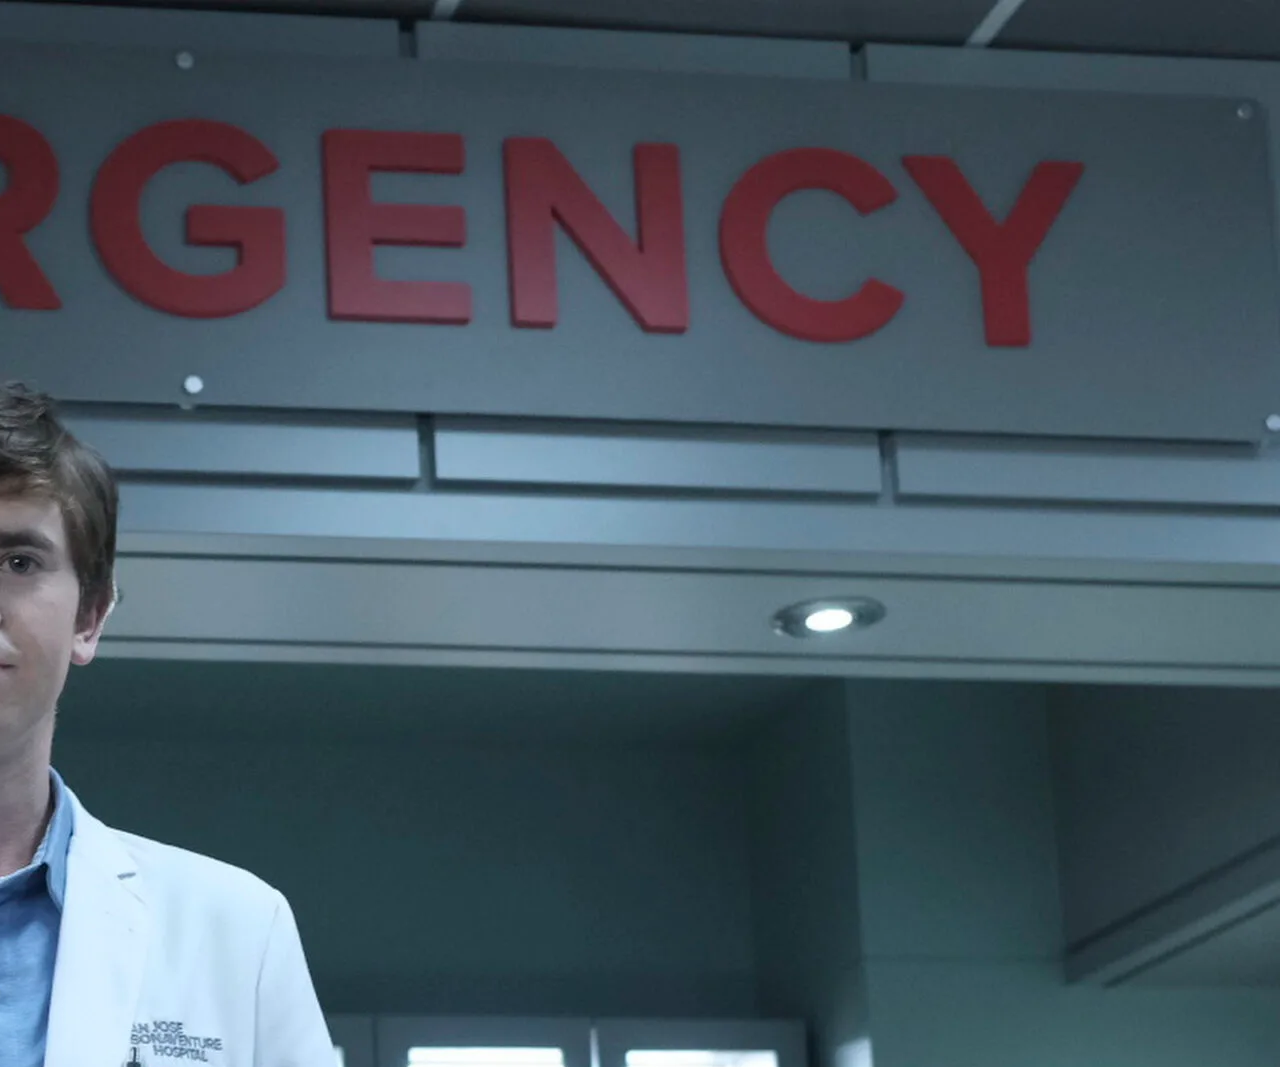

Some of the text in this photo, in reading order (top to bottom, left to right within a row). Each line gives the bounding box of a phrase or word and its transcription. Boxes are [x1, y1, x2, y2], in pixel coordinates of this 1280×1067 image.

[152, 1020, 183, 1034] JOSE
[131, 1033, 222, 1051] BONAVENTURE
[153, 1045, 208, 1062] HOSPITAL
